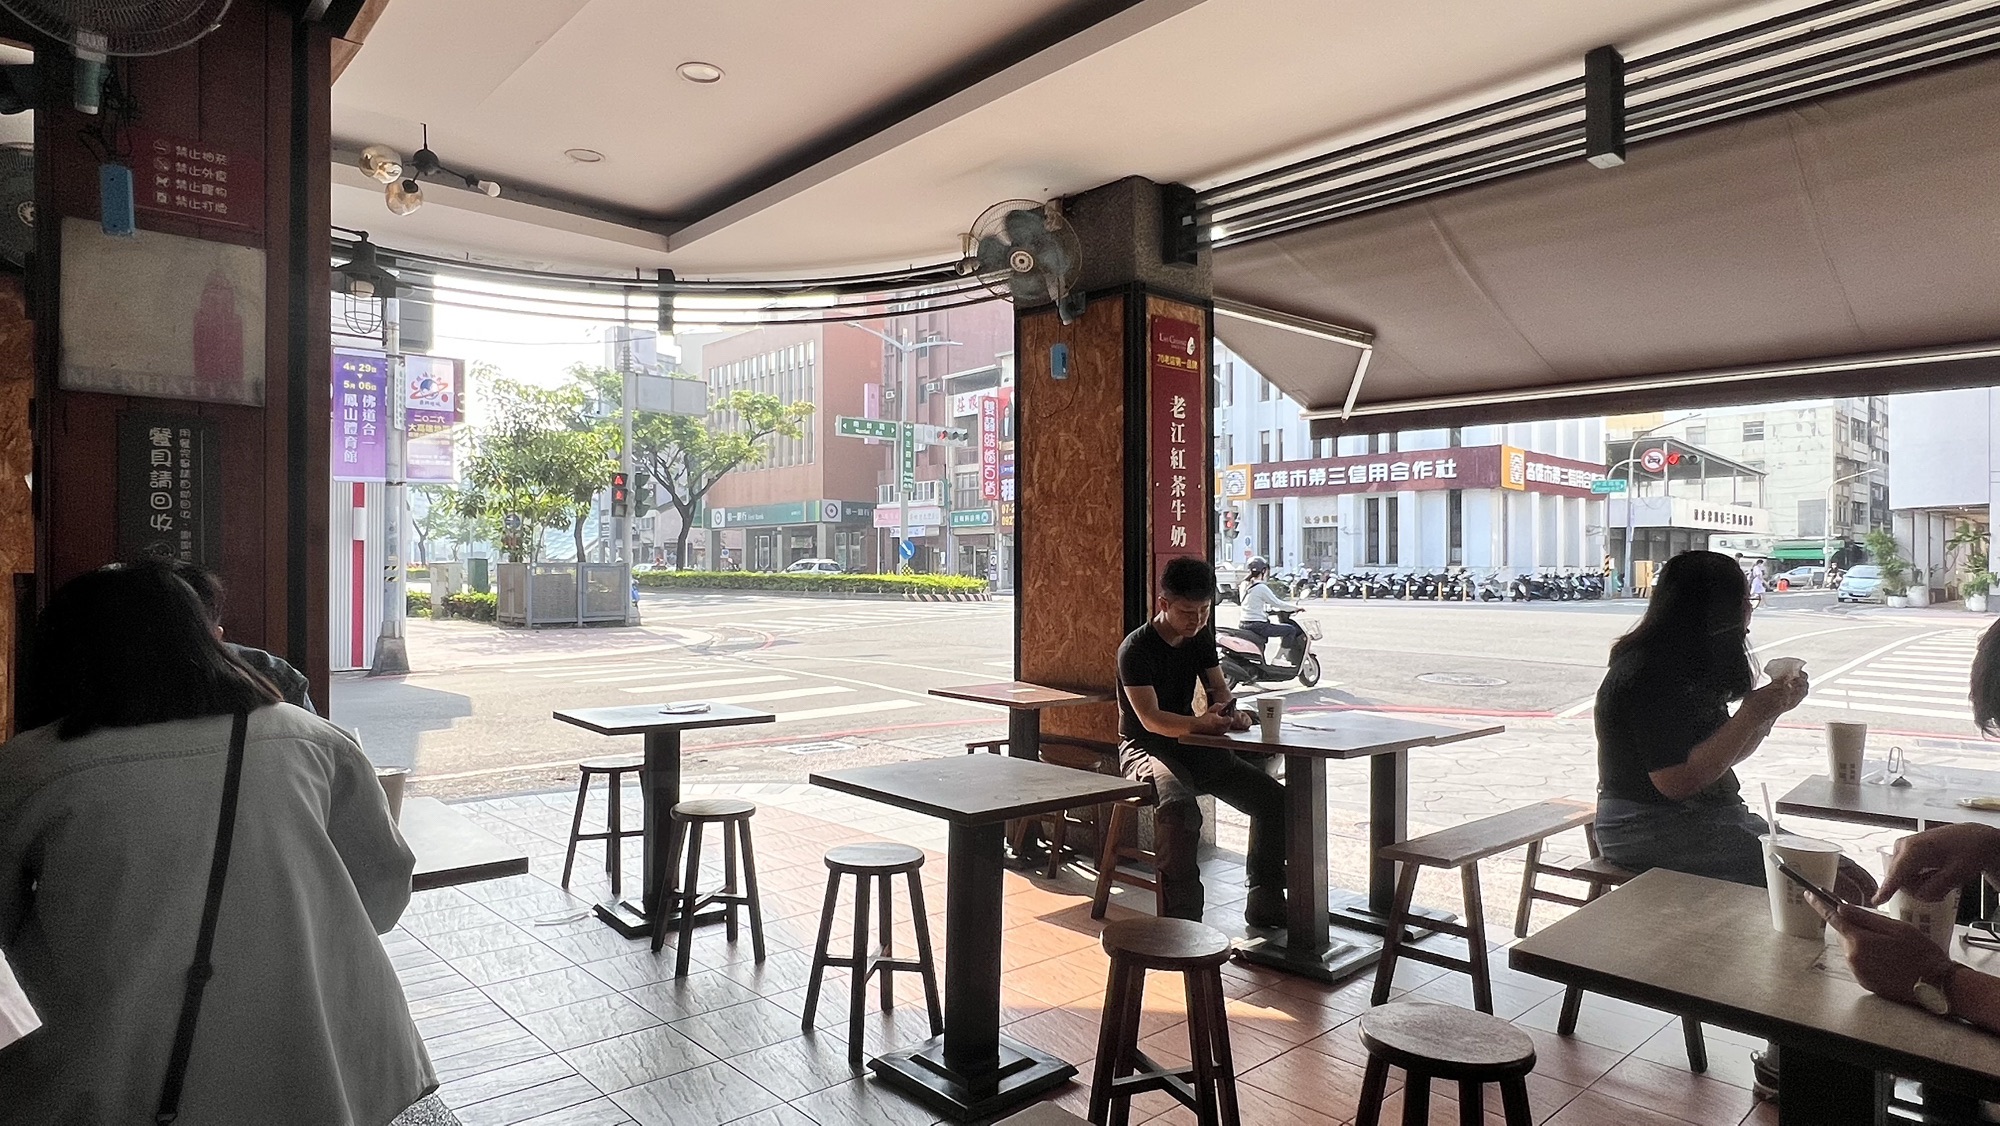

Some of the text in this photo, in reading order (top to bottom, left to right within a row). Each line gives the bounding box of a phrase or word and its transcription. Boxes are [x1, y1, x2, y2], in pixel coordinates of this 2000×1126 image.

[343, 393, 359, 464] 鳳山體育館
[362, 394, 377, 445] 佛道合一
[149, 426, 173, 532] 餐具請回收
[1169, 395, 1187, 547] 老江紅茶牛奶
[1253, 457, 1458, 491] 高雄市第三信用合作社
